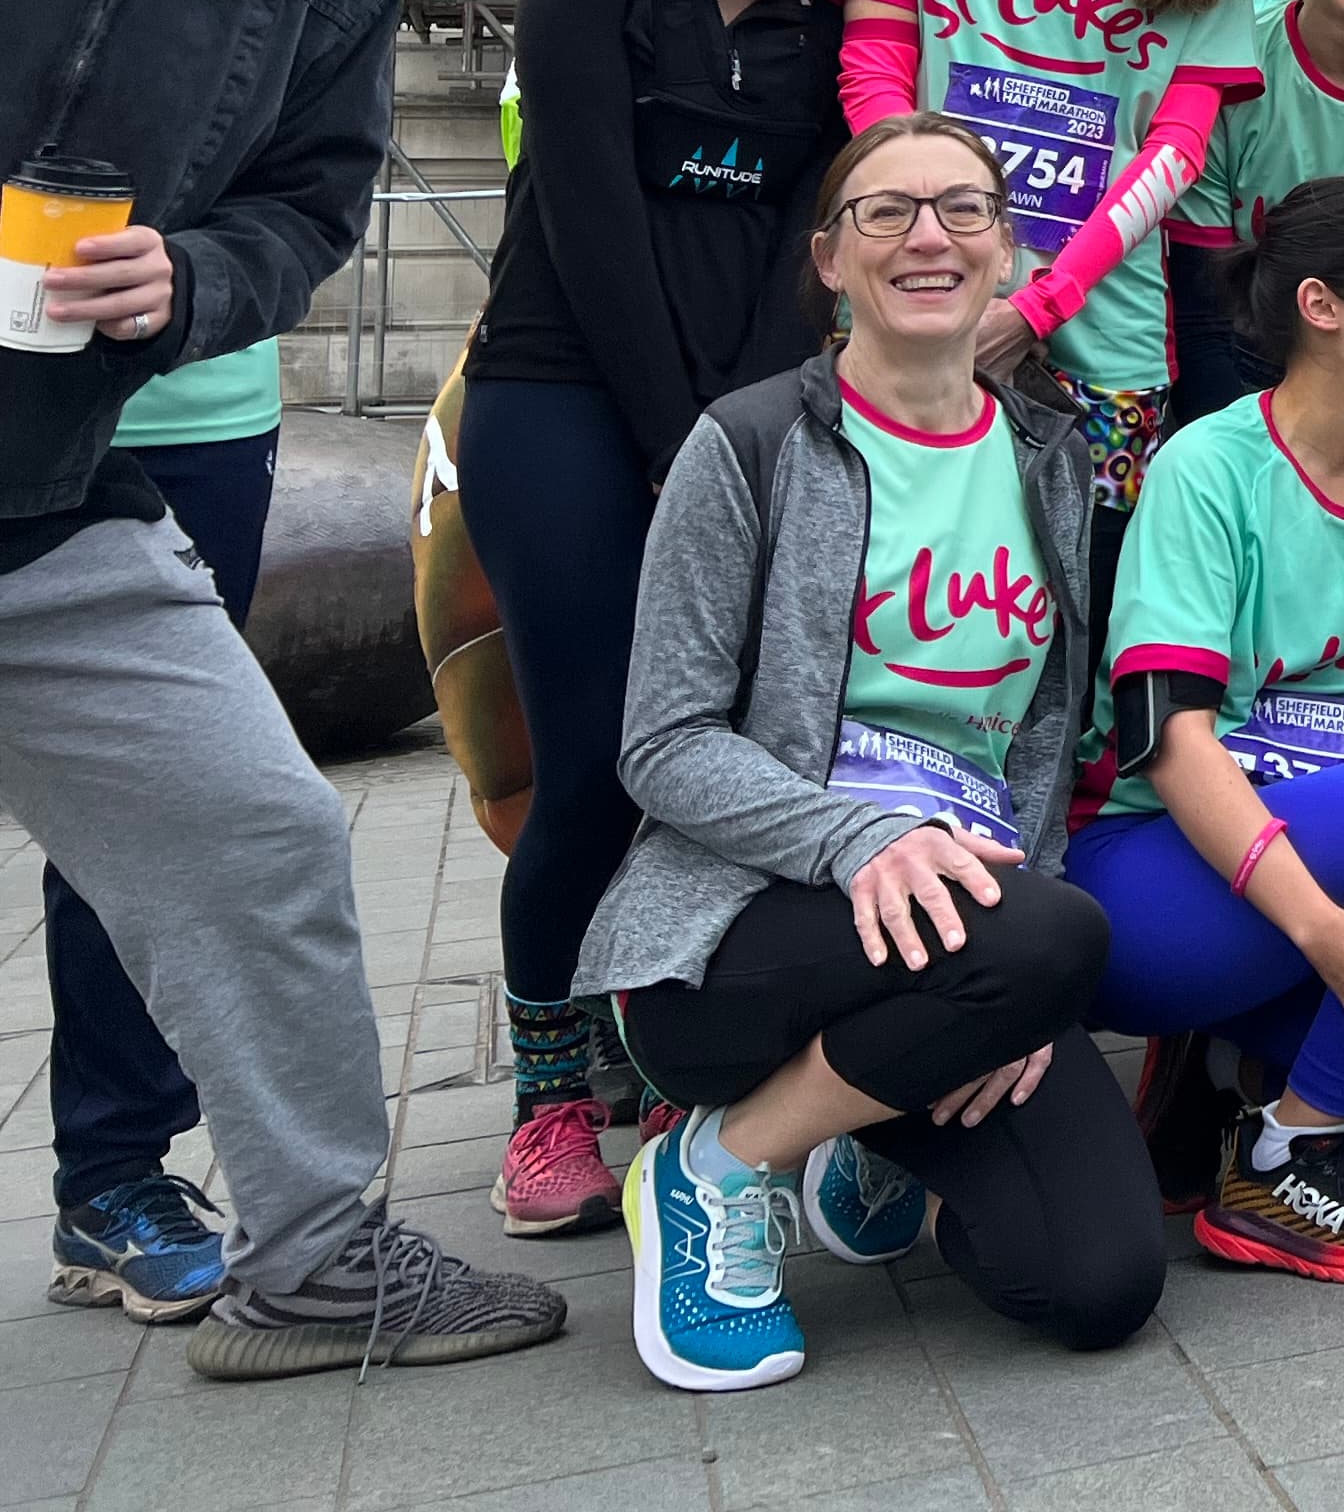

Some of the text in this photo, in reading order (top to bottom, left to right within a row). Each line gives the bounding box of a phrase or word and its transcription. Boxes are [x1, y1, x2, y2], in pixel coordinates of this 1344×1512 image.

[1005, 80, 1067, 102] SHEFFIELD
[1003, 92, 1105, 123] HALF MARATHON
[1067, 120, 1104, 140] 2023
[681, 160, 762, 184] RUNITUDE
[980, 136, 1085, 195] 754
[1007, 190, 1043, 208] AWN
[1278, 699, 1342, 718] SHEFFIELD
[1278, 714, 1311, 728] HALF
[886, 747, 922, 769] HALF
[888, 736, 952, 764] SHEFFIELD
